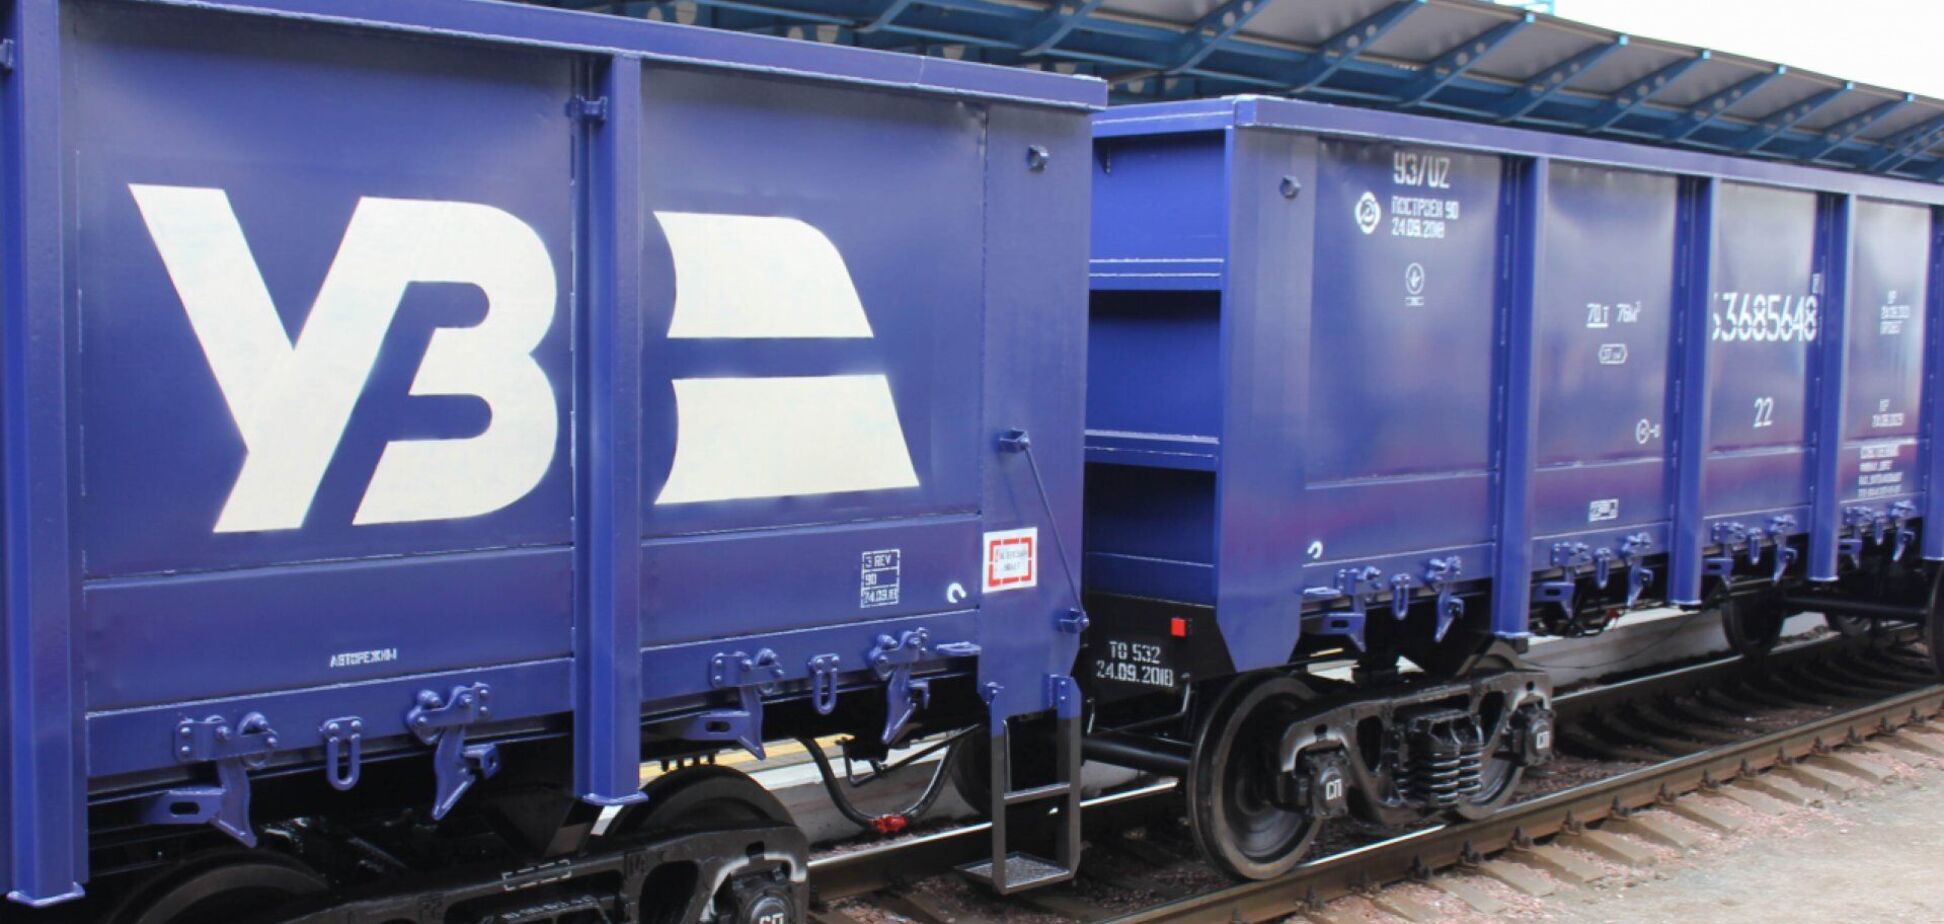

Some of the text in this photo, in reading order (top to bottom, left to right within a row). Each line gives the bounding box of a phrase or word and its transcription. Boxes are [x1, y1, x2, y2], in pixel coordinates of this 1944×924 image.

[1753, 397, 1774, 428] 22
[864, 554, 892, 568] 3 REV
[864, 573, 877, 586] 90
[1131, 643, 1161, 665] 532
[1096, 660, 1175, 688] 24.09.2018
